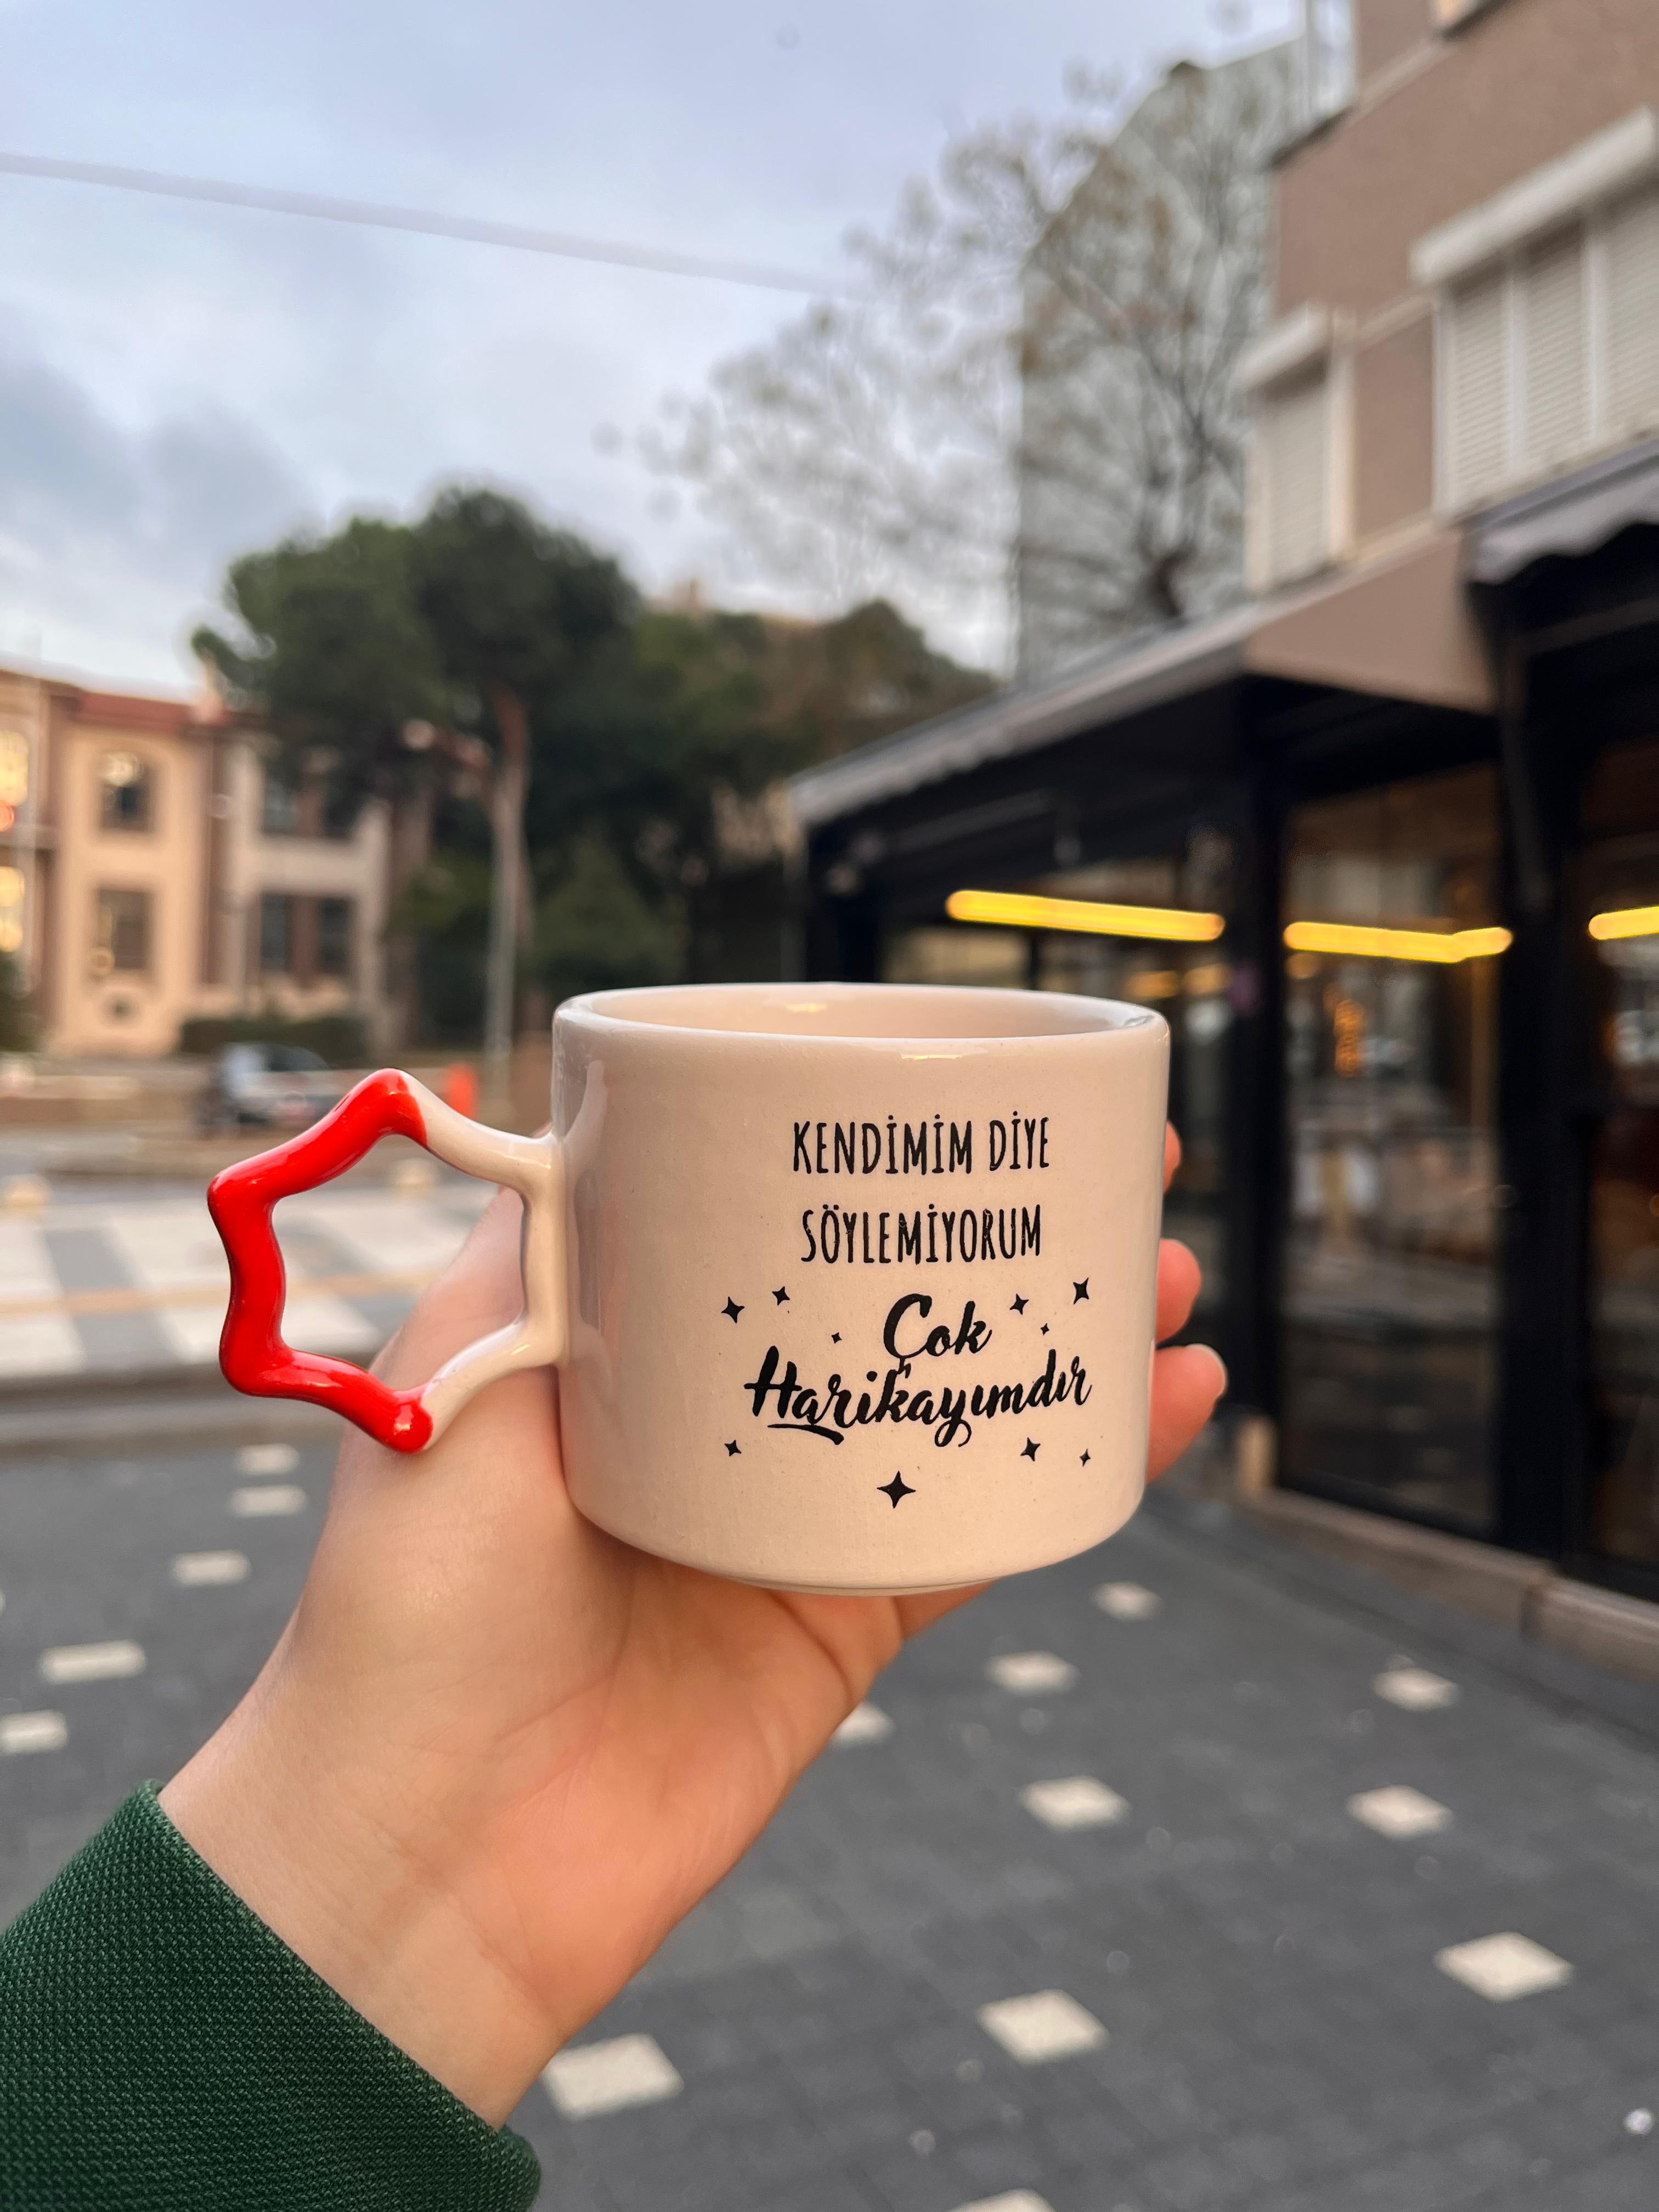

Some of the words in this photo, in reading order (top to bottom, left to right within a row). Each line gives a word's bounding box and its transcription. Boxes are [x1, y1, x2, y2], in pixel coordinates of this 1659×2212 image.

[793, 1114, 973, 1175] KENDİMİM
[989, 1110, 1050, 1171] DİYE
[800, 1204, 1041, 1266] SÖYLEMİYORUM
[883, 1293, 992, 1379] Çok
[743, 1345, 1092, 1448] Harikayımdır
